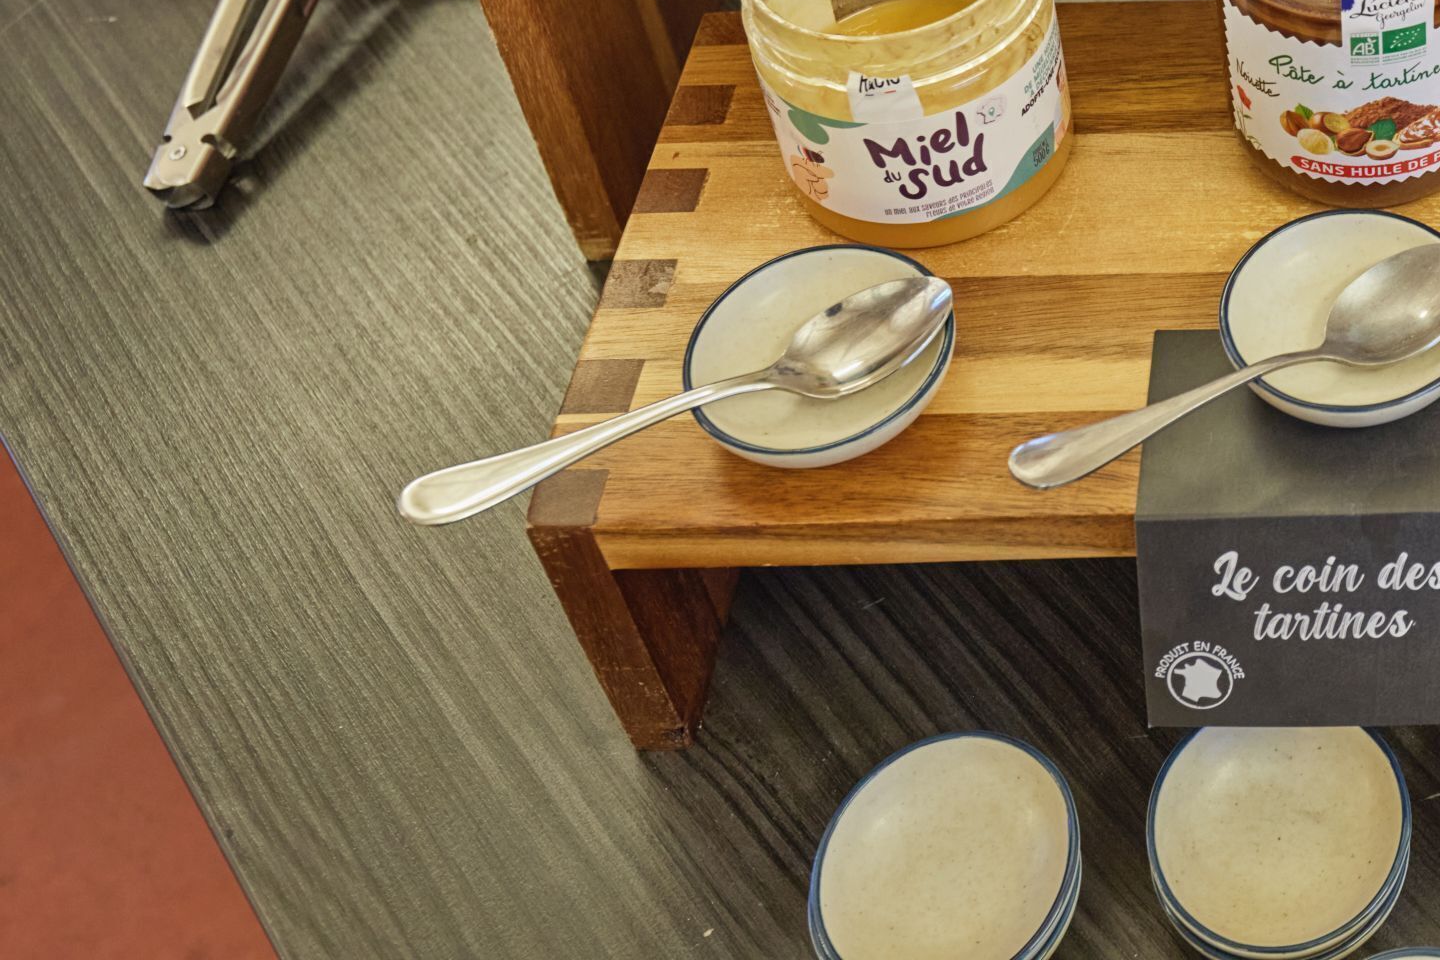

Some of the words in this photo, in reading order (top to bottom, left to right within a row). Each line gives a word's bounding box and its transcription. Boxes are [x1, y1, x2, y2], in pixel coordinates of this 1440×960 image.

[1269, 54, 1325, 84] Pâte
[1333, 70, 1354, 90] à
[863, 111, 970, 169] Miel
[883, 169, 902, 184] du
[898, 133, 988, 200] Sud
[1300, 157, 1346, 177] SANS
[1350, 162, 1402, 177] HUILE
[1407, 155, 1430, 171] DE
[1211, 551, 1260, 602] Le
[1272, 555, 1365, 594] coin
[1253, 601, 1416, 641] tartines
[1154, 642, 1190, 679] PRODUIT
[1193, 640, 1211, 652] EN
[1212, 644, 1246, 680] FRANCE
